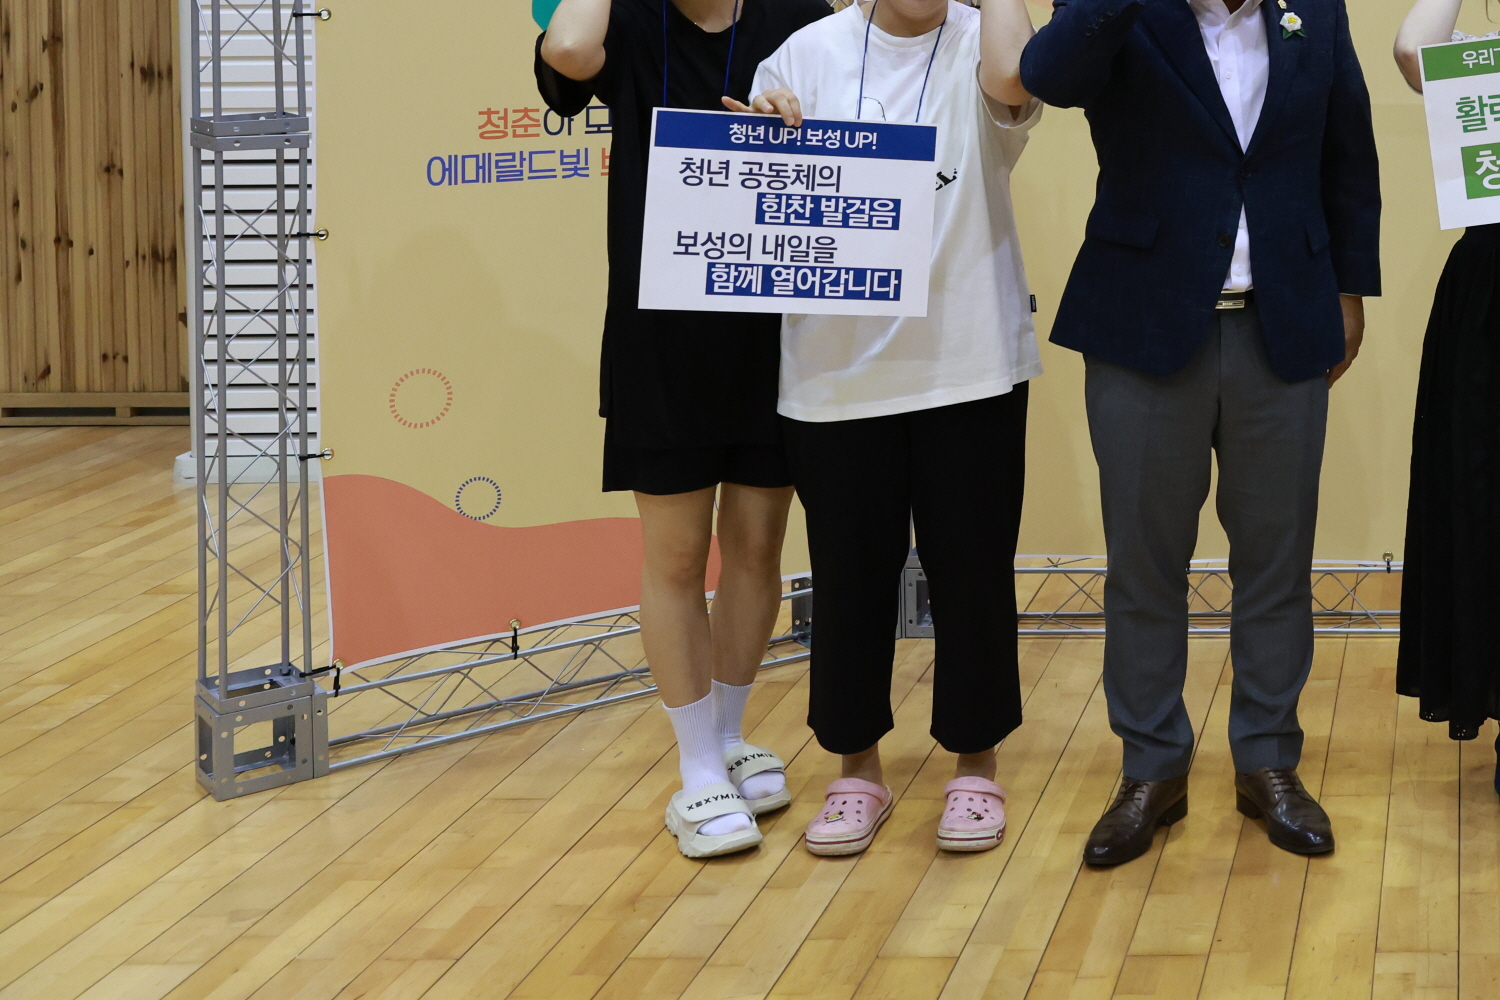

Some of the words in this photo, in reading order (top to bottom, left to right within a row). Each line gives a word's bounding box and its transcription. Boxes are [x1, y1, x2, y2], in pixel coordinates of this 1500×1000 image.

[728, 122, 765, 145] 청년
[768, 127, 802, 146] UP!
[805, 129, 841, 149] 보성
[844, 131, 878, 150] UP!
[426, 147, 590, 187] 에메랄드빛
[679, 157, 730, 187] 청년
[738, 160, 842, 193] 공동체의
[761, 194, 814, 224] 힘찬
[820, 198, 897, 228] 발걸음
[673, 230, 753, 261] 보성의
[761, 234, 838, 264] 내일을
[710, 263, 763, 295] 함께
[770, 266, 899, 299] 열어갑니다
